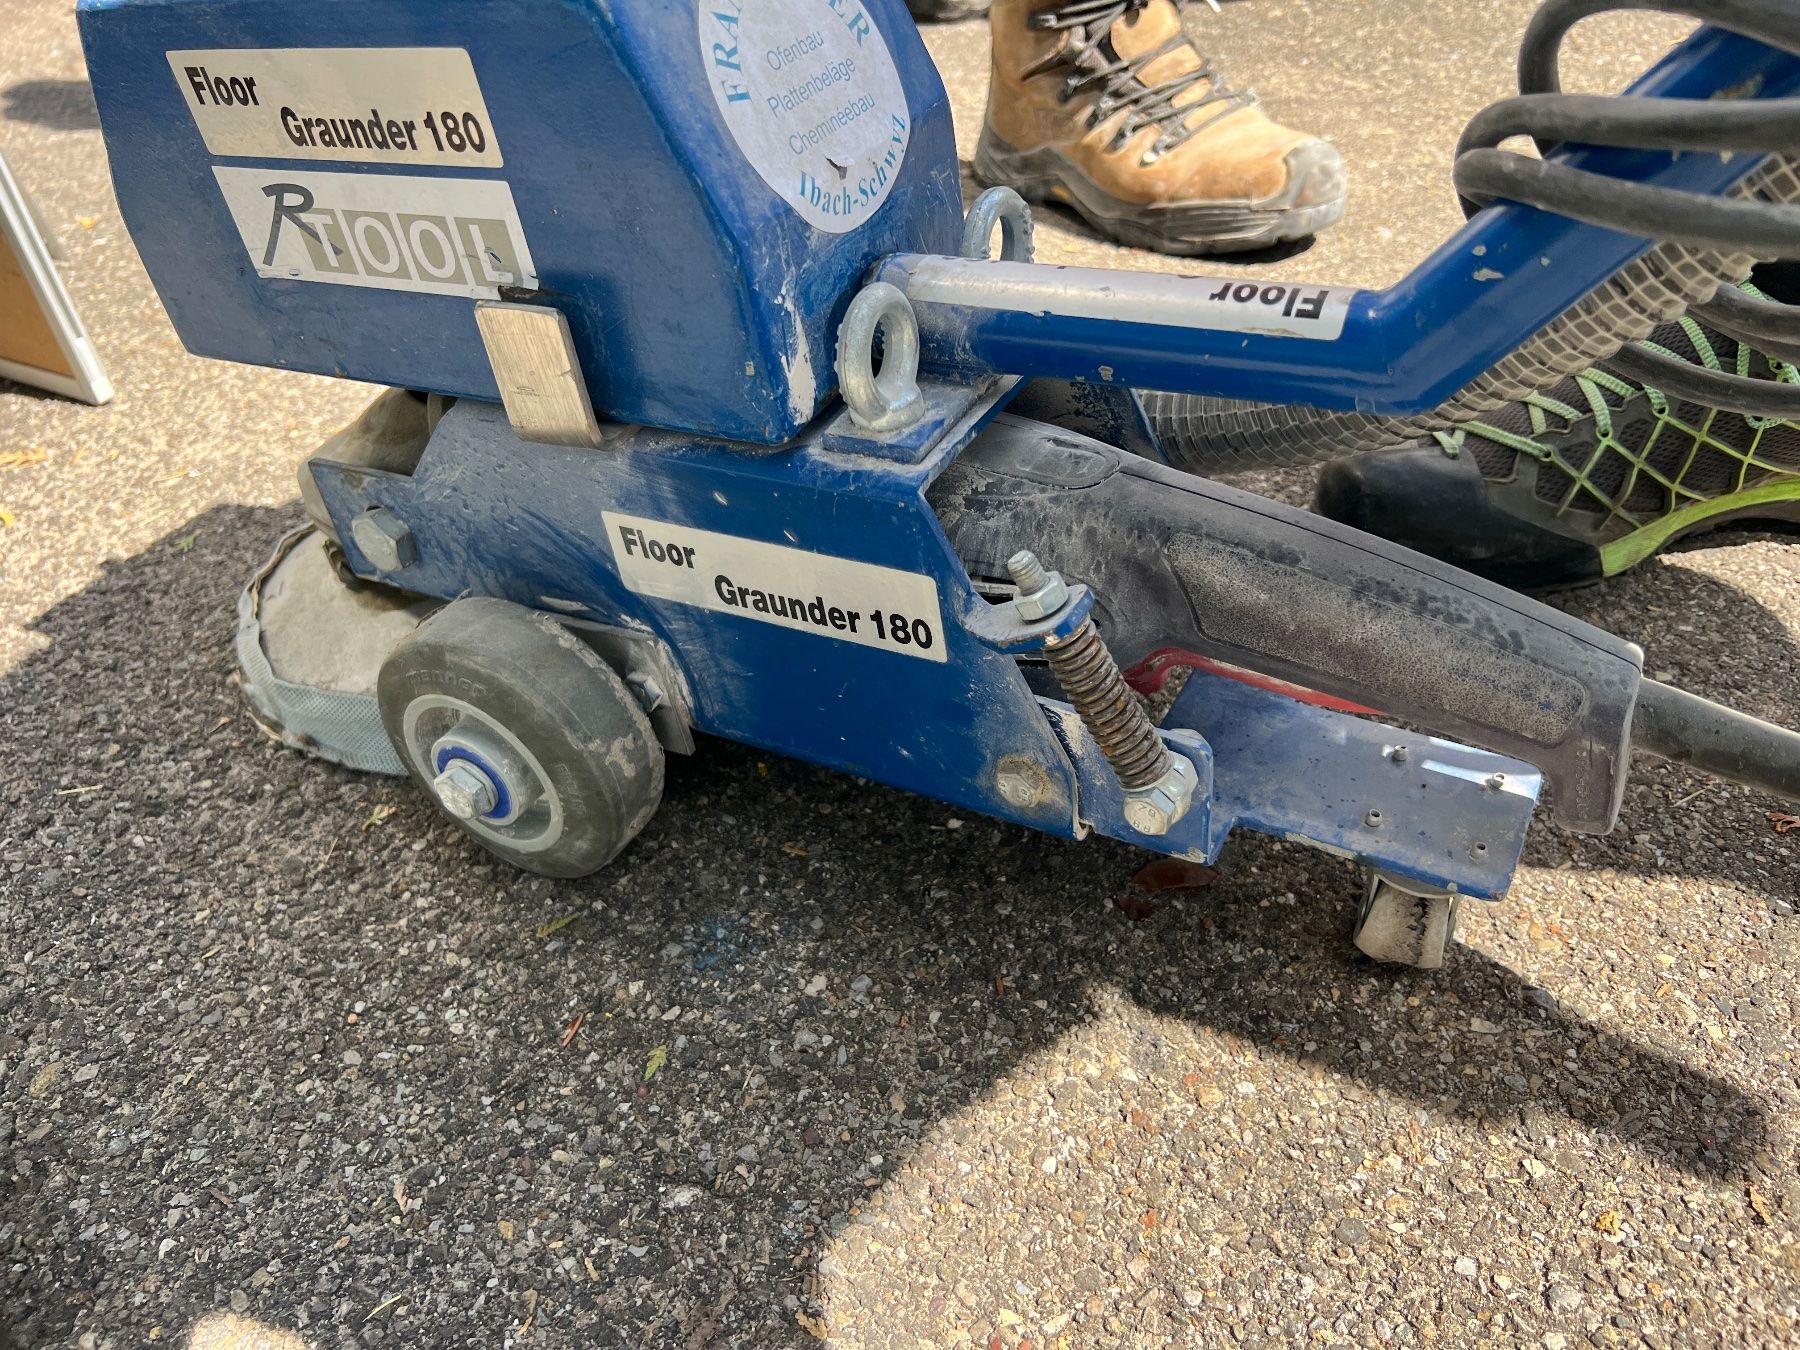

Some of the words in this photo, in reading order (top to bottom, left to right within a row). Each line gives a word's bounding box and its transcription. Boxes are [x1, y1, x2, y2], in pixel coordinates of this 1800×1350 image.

[712, 0, 752, 104] FRA
[766, 30, 825, 71] Ofenbau
[184, 66, 260, 106] Floor
[766, 55, 856, 118] Plattenbeläge
[280, 106, 418, 151] Graunder
[424, 111, 487, 154] 180
[788, 92, 876, 155] Cheminéebau
[799, 113, 907, 216] Ibach-Schwyz
[1208, 282, 1330, 320] Floor
[619, 525, 696, 570] Floor
[714, 574, 861, 634] Graunder
[870, 609, 934, 651] 180
